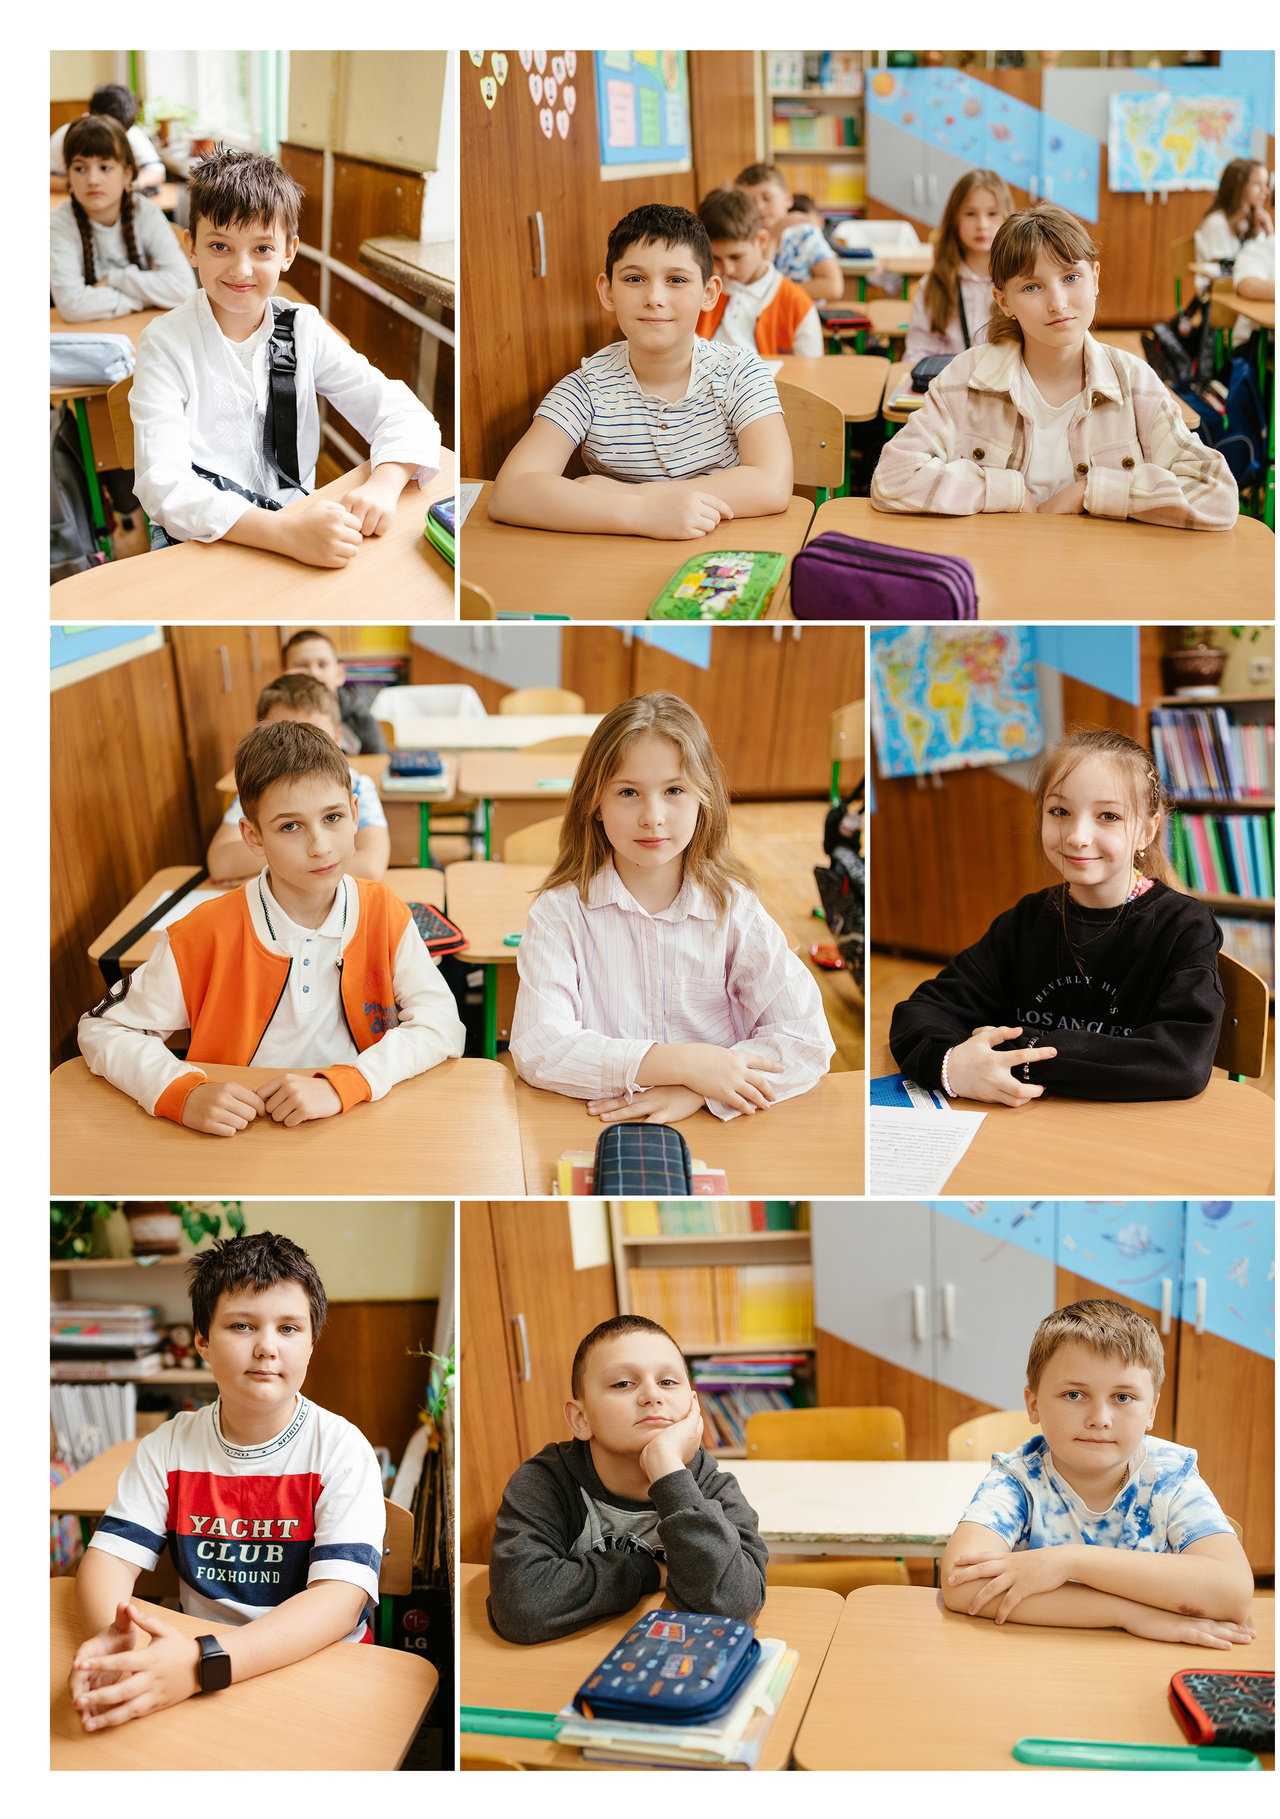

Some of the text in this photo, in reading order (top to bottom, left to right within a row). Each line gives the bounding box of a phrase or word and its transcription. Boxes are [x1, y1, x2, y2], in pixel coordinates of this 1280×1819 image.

[1036, 976, 1118, 1015] BEVERLY HIS
[1017, 1008, 1052, 1025] LOS
[189, 1514, 300, 1539] YACHT
[197, 1540, 284, 1563] CLUB
[196, 1566, 280, 1584] FOXHOUND
[404, 1637, 428, 1649] LG
